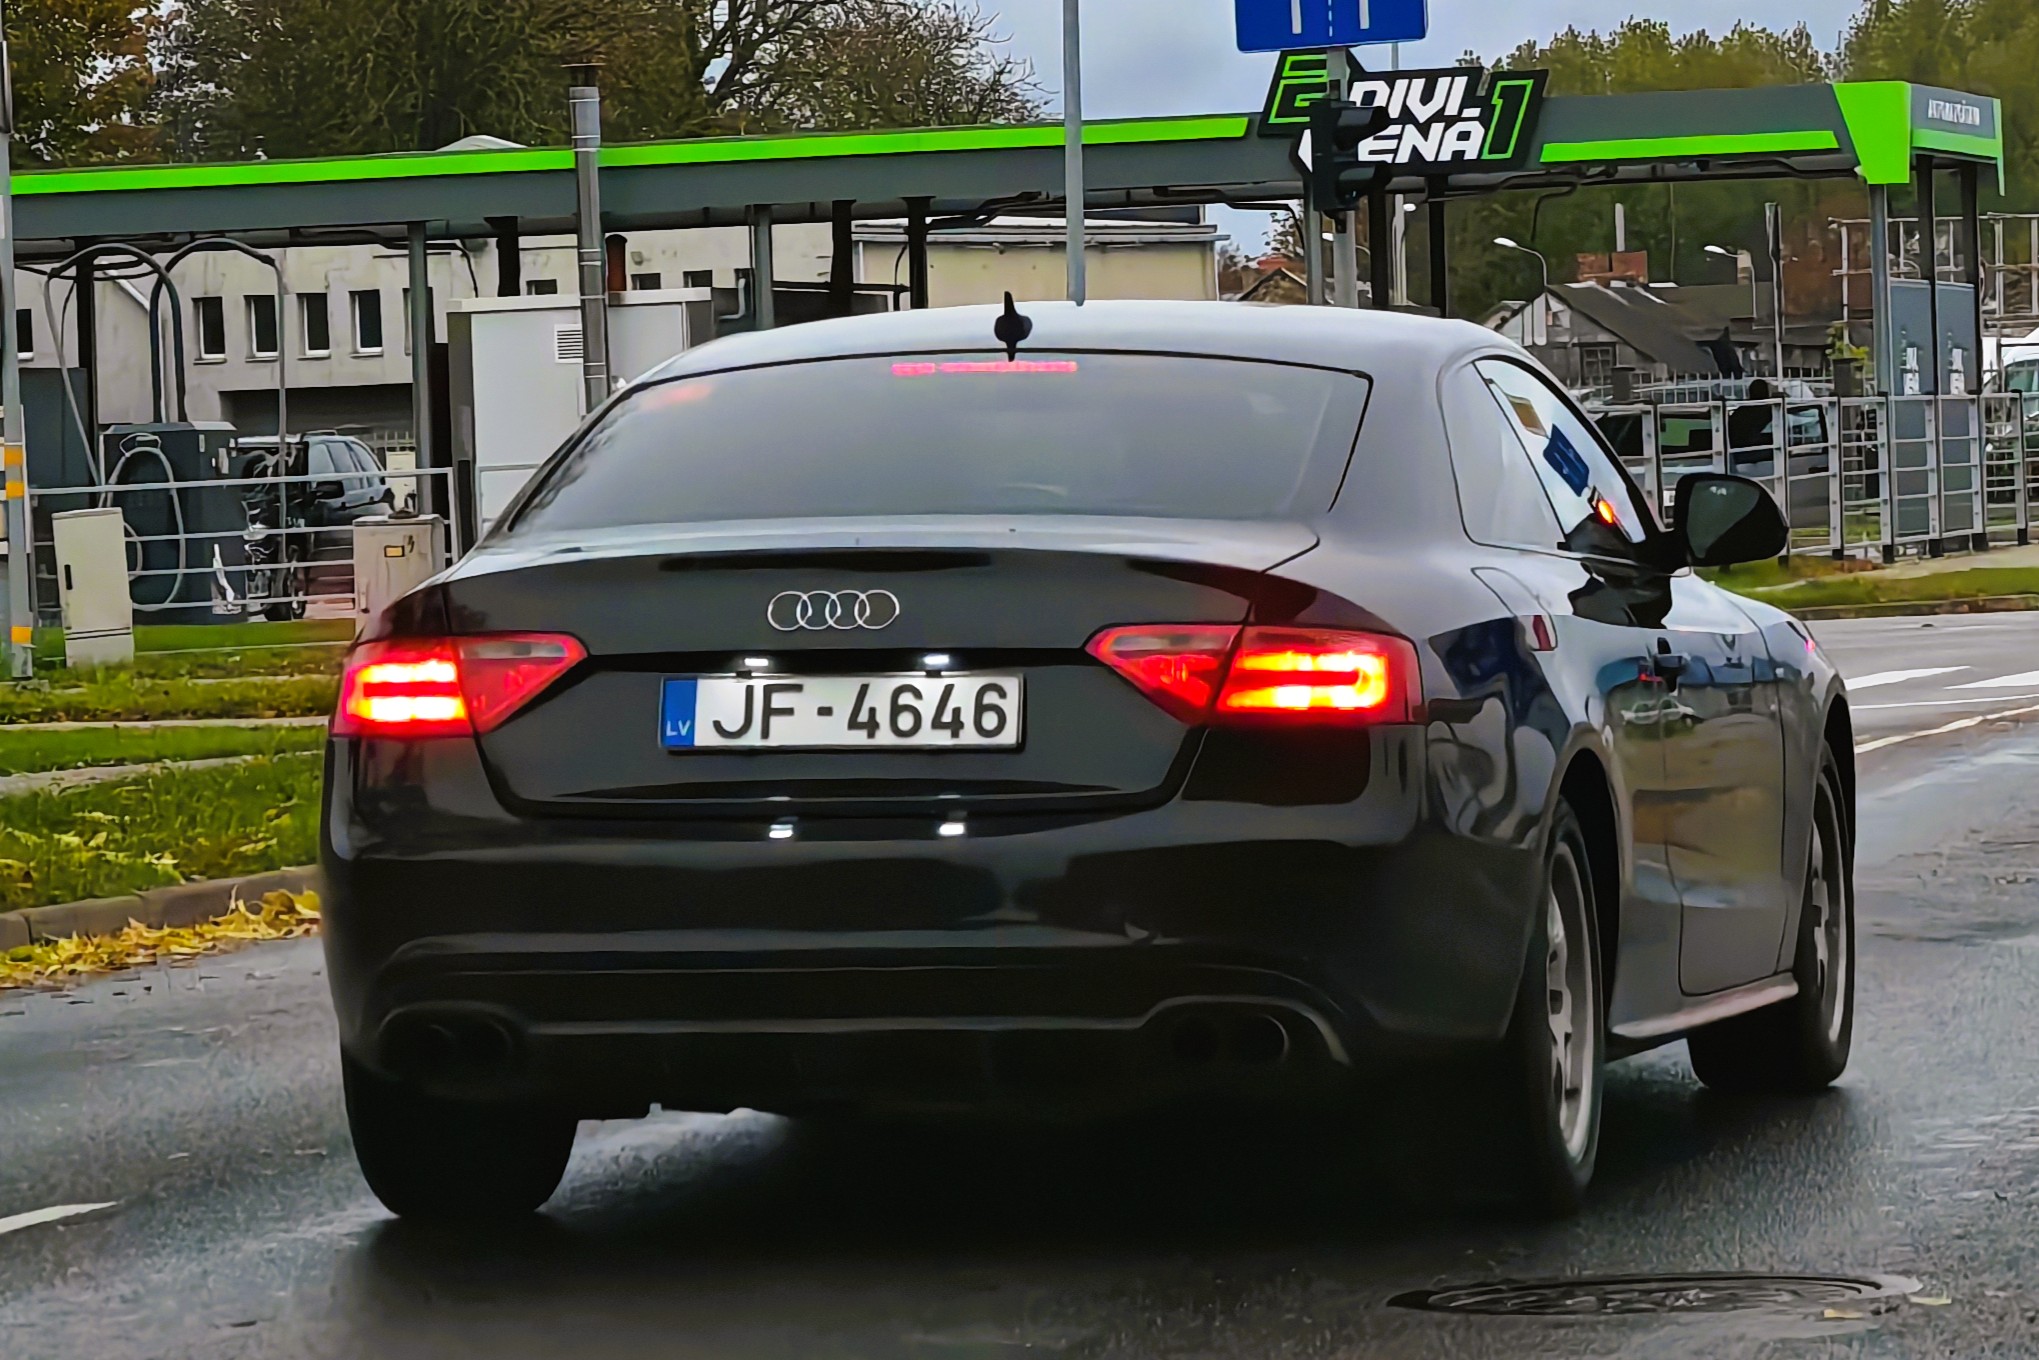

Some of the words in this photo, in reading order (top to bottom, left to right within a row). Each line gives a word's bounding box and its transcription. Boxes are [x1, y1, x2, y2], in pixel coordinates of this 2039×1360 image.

[1481, 79, 1534, 160] 1
[666, 719, 691, 737] LV
[712, 683, 1007, 740] JF-4646
